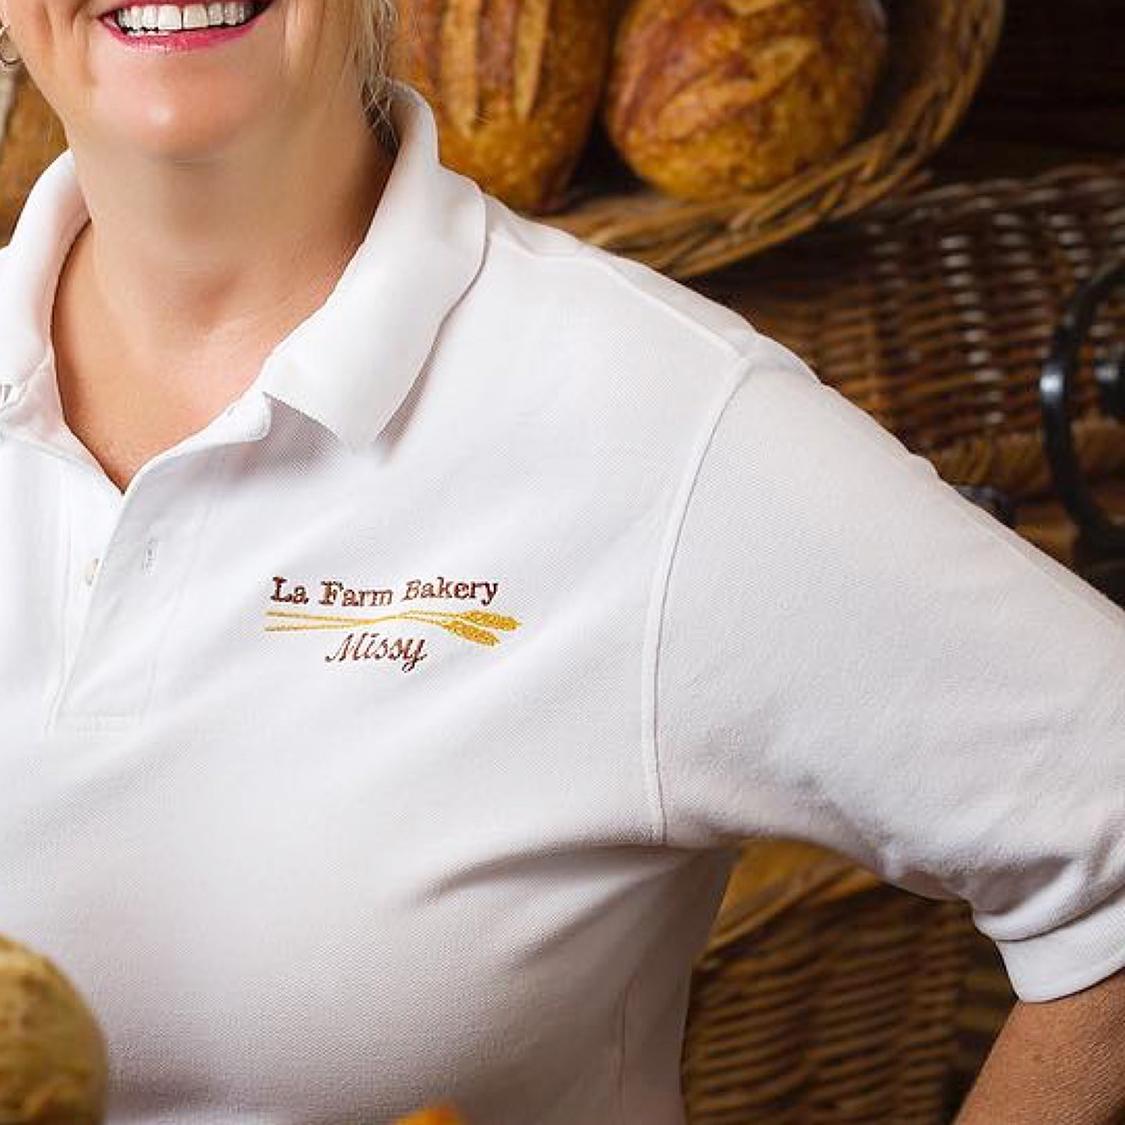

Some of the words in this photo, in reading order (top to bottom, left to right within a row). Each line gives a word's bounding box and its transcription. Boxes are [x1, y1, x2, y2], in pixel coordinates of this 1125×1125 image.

[270, 576, 309, 605] La
[319, 580, 394, 607] Farm
[401, 576, 499, 607] Bakery
[324, 632, 428, 673] Missy
